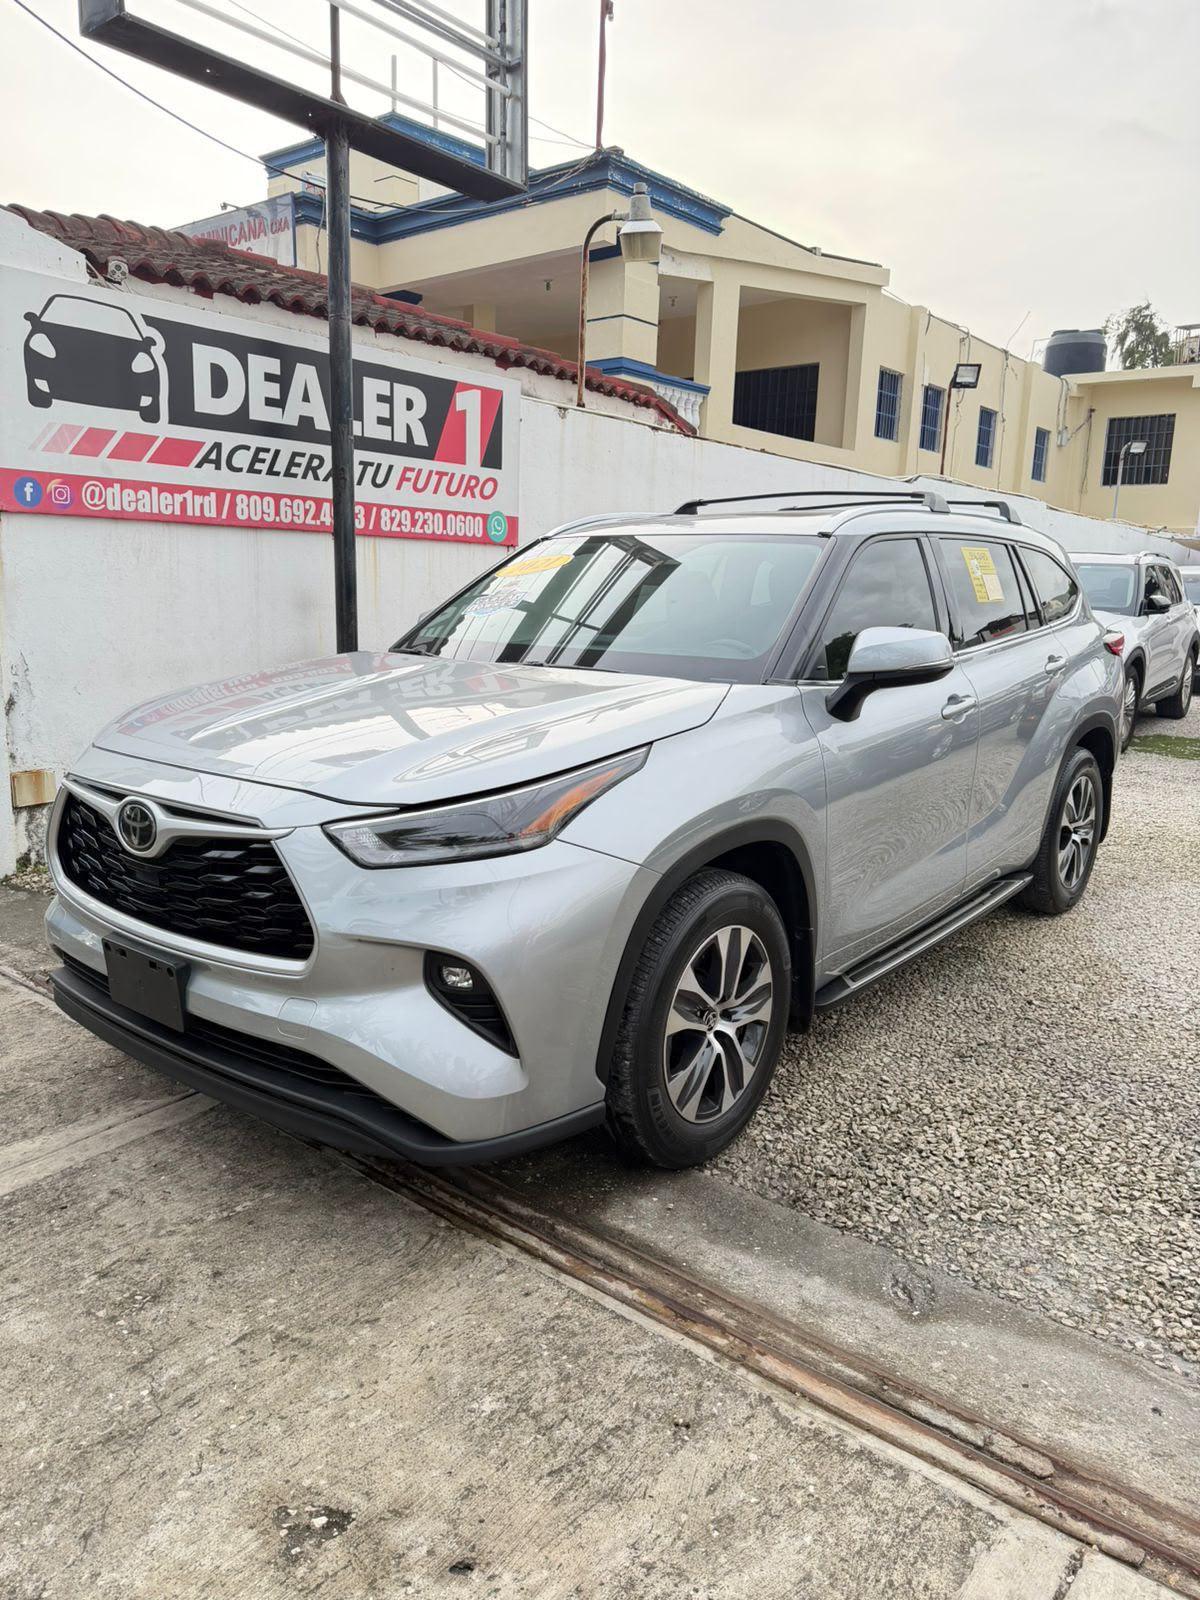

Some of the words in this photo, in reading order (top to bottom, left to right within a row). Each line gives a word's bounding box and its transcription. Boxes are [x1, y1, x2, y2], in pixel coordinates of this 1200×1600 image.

[192, 342, 429, 447] DEAER
[455, 388, 482, 468] 1
[82, 480, 217, 518] @dealer1rd
[235, 494, 366, 530] 809.692.43
[380, 507, 484, 538] 829.230.0600
[356, 460, 394, 489] TU
[395, 466, 498, 500] FUTURO
